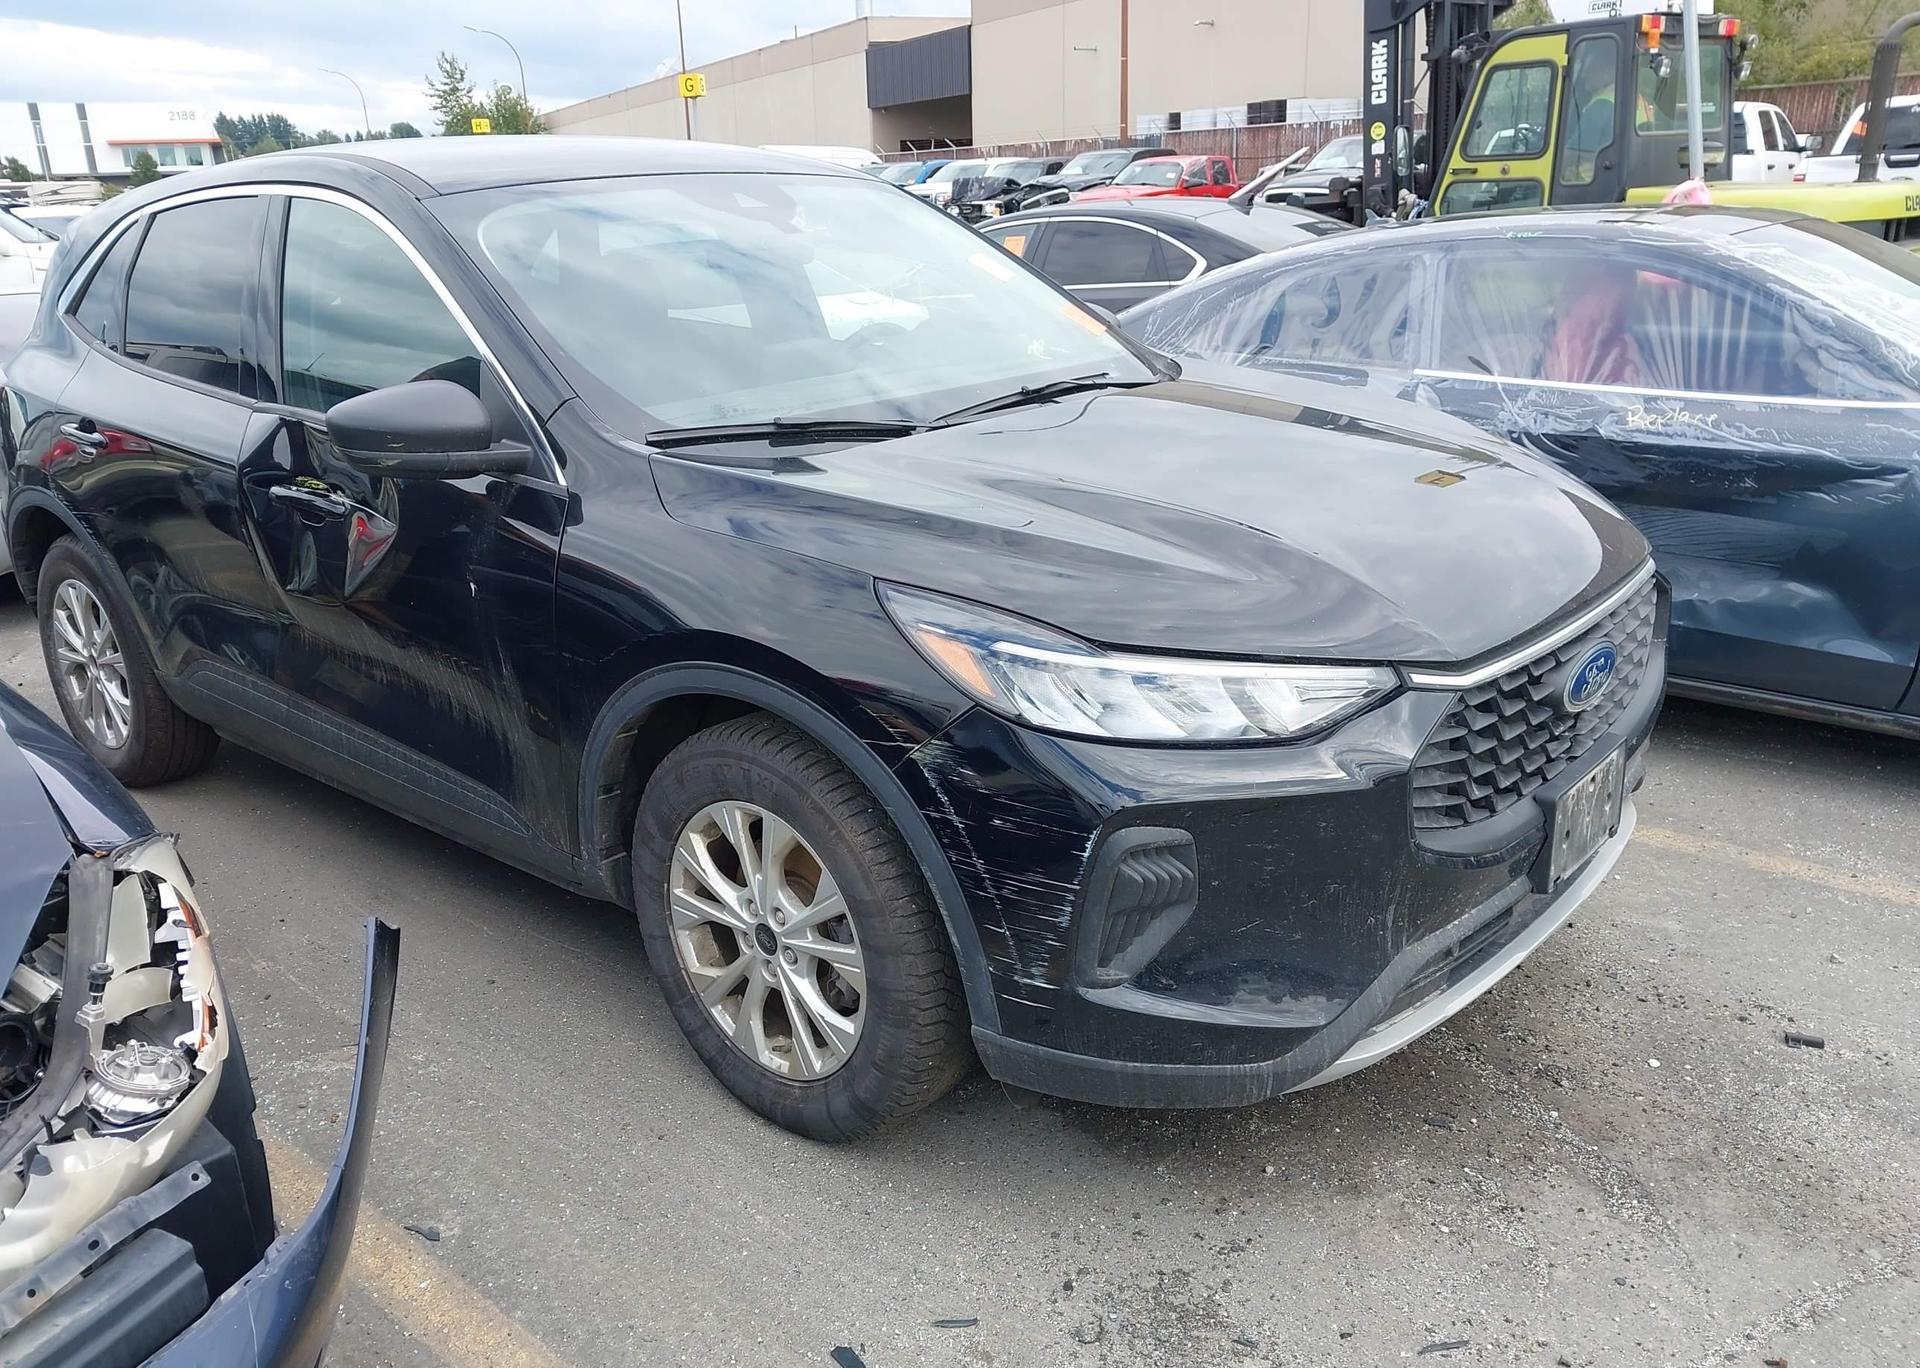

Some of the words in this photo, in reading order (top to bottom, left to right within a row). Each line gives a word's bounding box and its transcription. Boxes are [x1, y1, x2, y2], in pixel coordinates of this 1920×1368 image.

[1592, 1, 1618, 11] CLARK
[1371, 39, 1388, 105] CLARK
[684, 77, 694, 92] G
[168, 110, 196, 121] 2188
[475, 121, 482, 131] H
